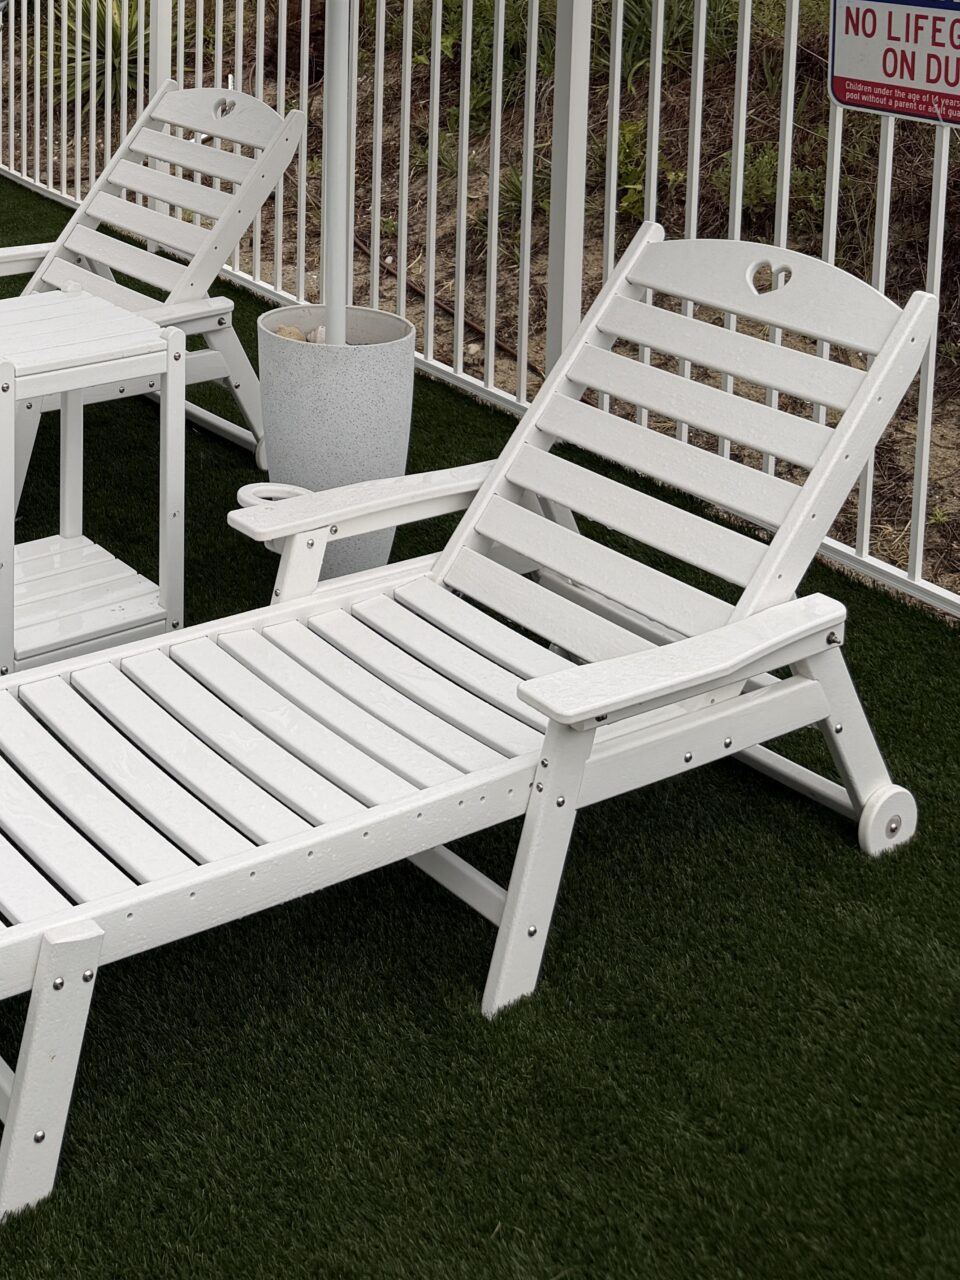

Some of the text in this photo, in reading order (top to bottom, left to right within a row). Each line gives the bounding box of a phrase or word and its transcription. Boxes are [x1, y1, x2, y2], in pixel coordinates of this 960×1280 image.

[844, 6, 960, 51] NO LIFEG
[882, 48, 960, 88] ON DU
[845, 81, 872, 93] Children
[873, 87, 893, 96] under
[894, 89, 906, 99] the
[907, 93, 920, 102] age
[922, 94, 930, 102] of
[941, 97, 960, 107] years
[845, 91, 860, 100] pool
[861, 94, 887, 105] without
[894, 100, 916, 110] parent
[918, 103, 926, 111] or
